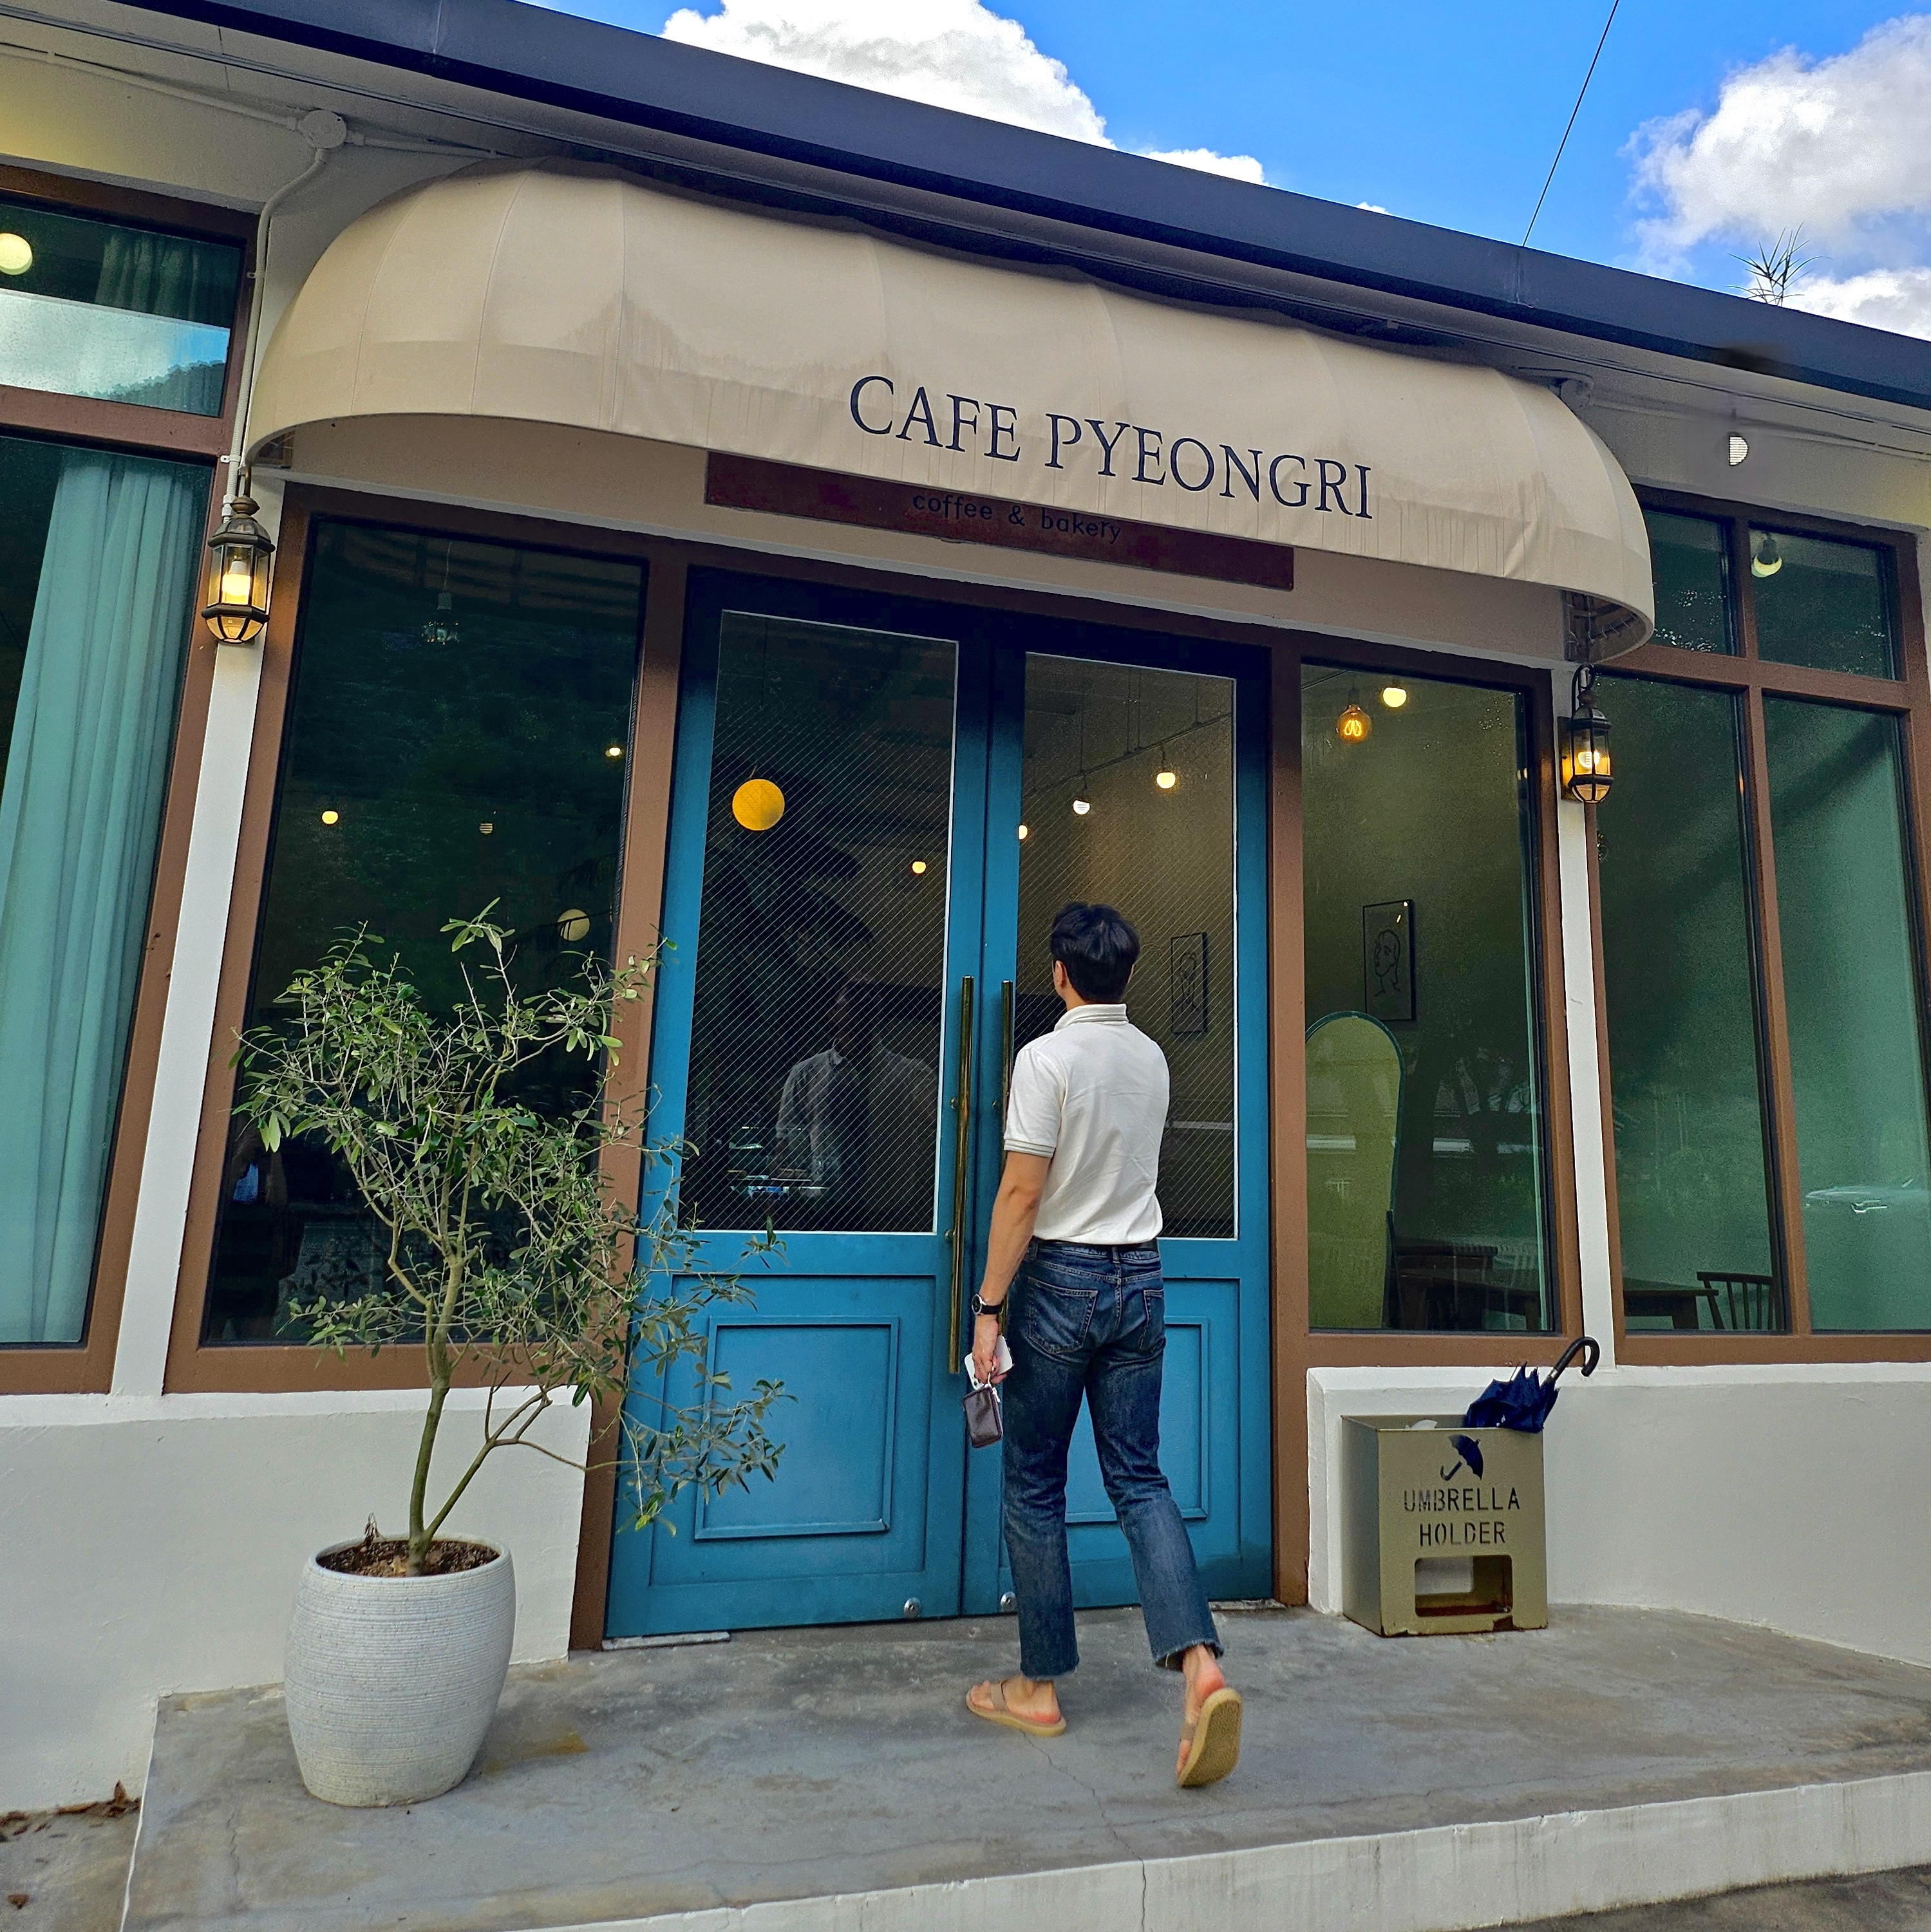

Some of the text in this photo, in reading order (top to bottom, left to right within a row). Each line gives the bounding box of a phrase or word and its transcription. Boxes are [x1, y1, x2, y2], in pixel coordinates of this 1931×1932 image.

[849, 375, 1373, 520] CAFE PYEONGRI
[913, 494, 1122, 545] coffee & bakery
[1404, 1487, 1520, 1512] UMBRELLA
[1419, 1521, 1506, 1546] HOLDER
